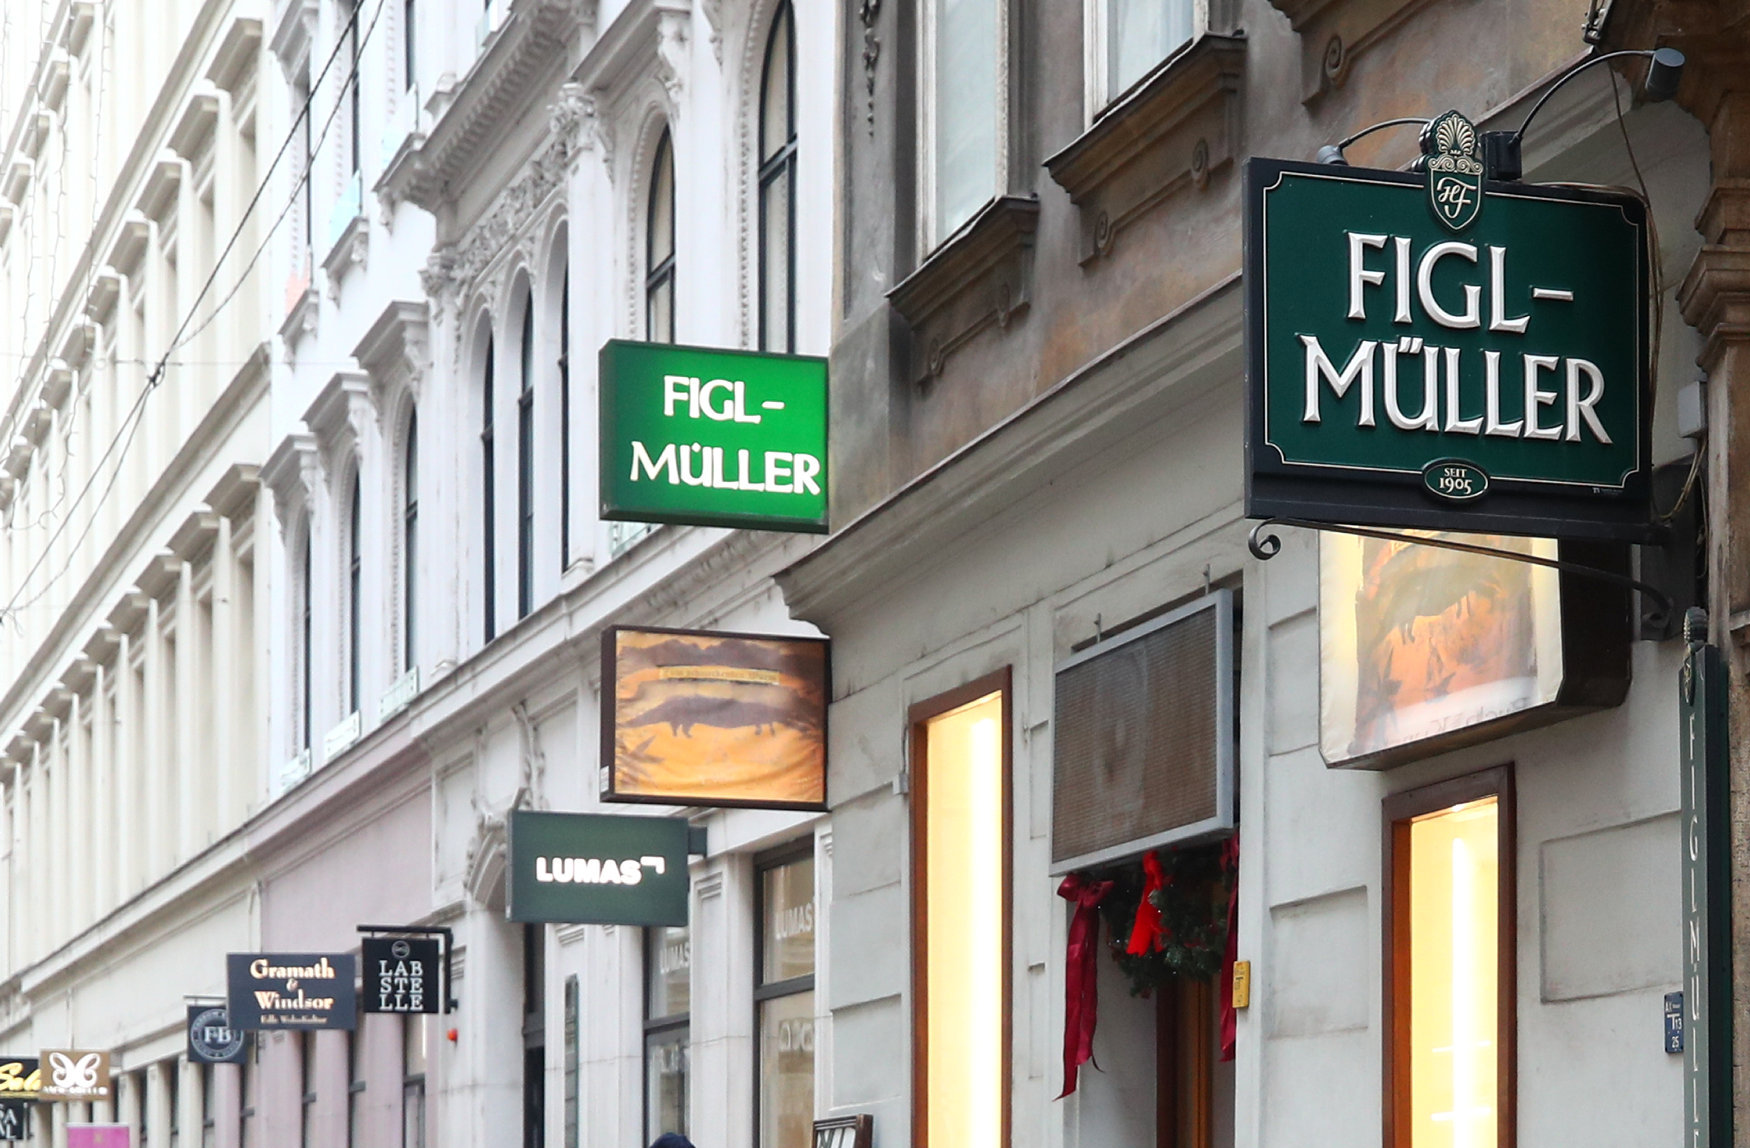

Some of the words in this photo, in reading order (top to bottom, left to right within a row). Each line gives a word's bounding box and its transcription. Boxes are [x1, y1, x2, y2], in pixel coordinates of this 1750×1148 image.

[1347, 231, 1574, 334] FIGL-
[664, 375, 785, 424] FIGL-
[1299, 335, 1613, 444] MÜLLER
[630, 441, 821, 495] MÜLLER
[1444, 467, 1468, 478] SEIT
[1439, 477, 1473, 495] 1905
[536, 857, 642, 886] LUMAS
[250, 957, 335, 980] Gramath
[379, 960, 423, 977] LAB
[380, 977, 423, 994] STE
[254, 988, 334, 1011] Windsor
[379, 994, 423, 1011] LLE
